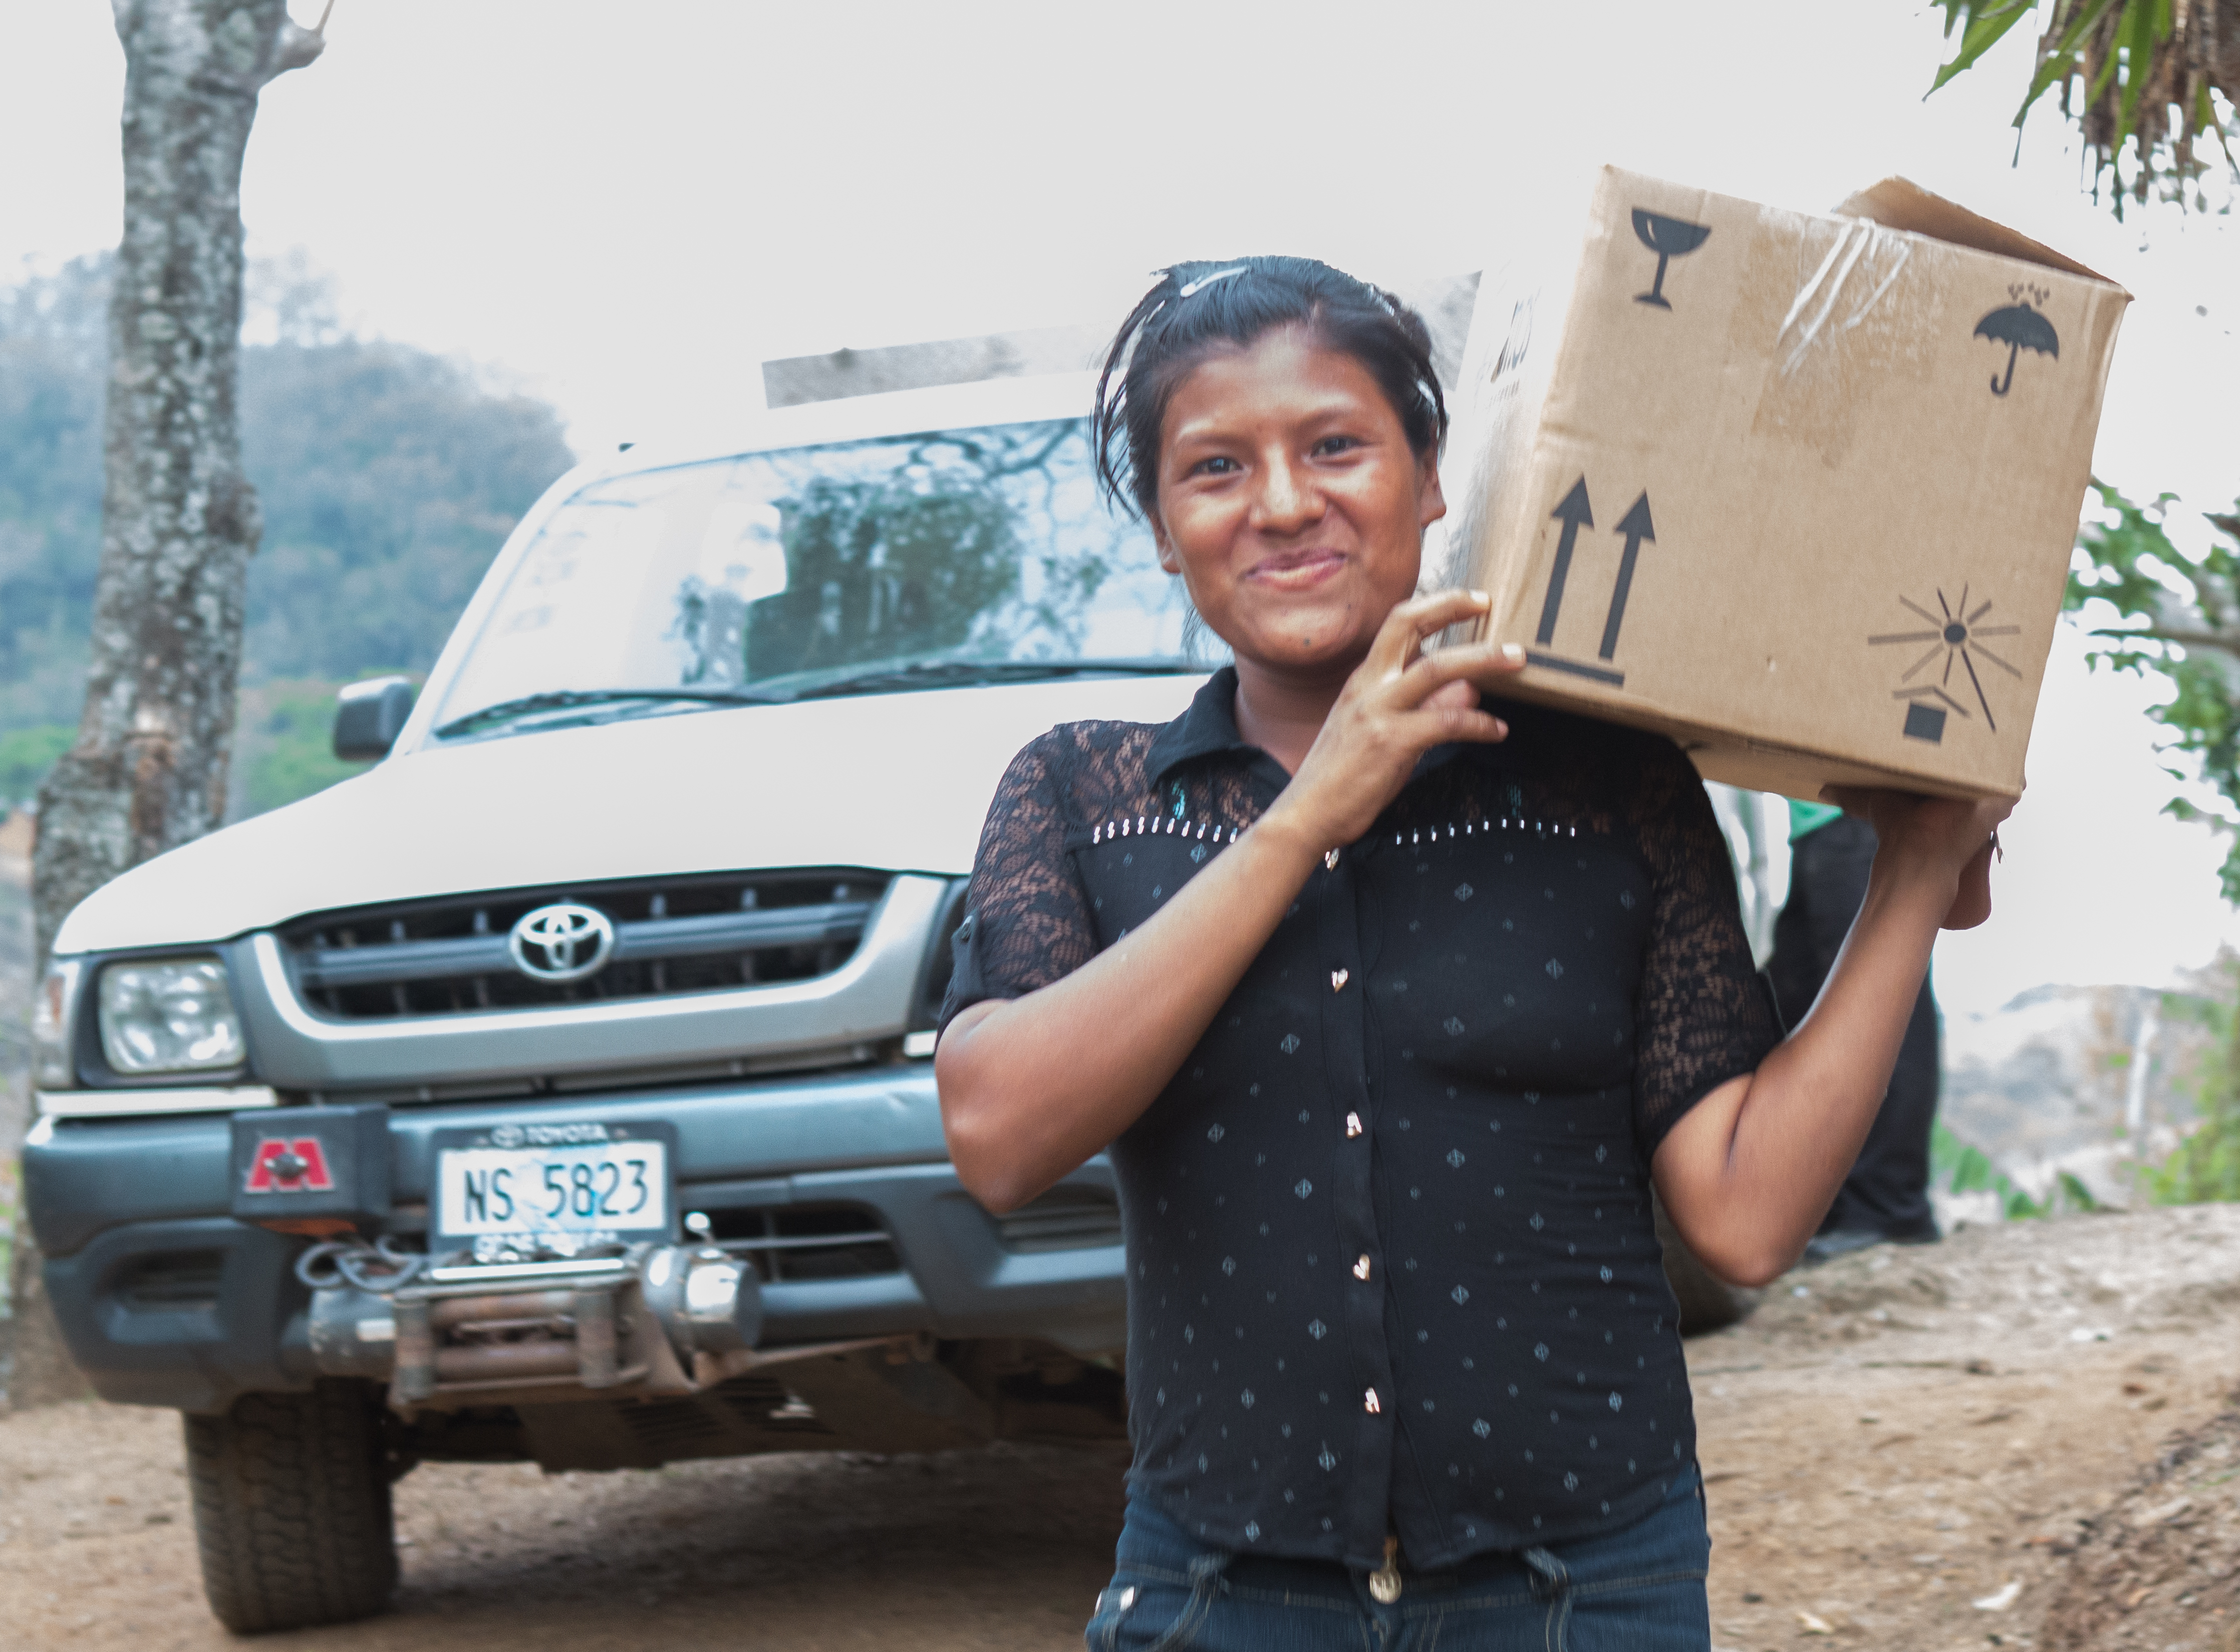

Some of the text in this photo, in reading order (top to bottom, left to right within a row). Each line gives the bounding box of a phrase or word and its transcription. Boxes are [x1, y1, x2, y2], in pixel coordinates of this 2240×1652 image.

[526, 1125, 608, 1143] TOYOTA
[464, 1159, 649, 1223] NS 5823
